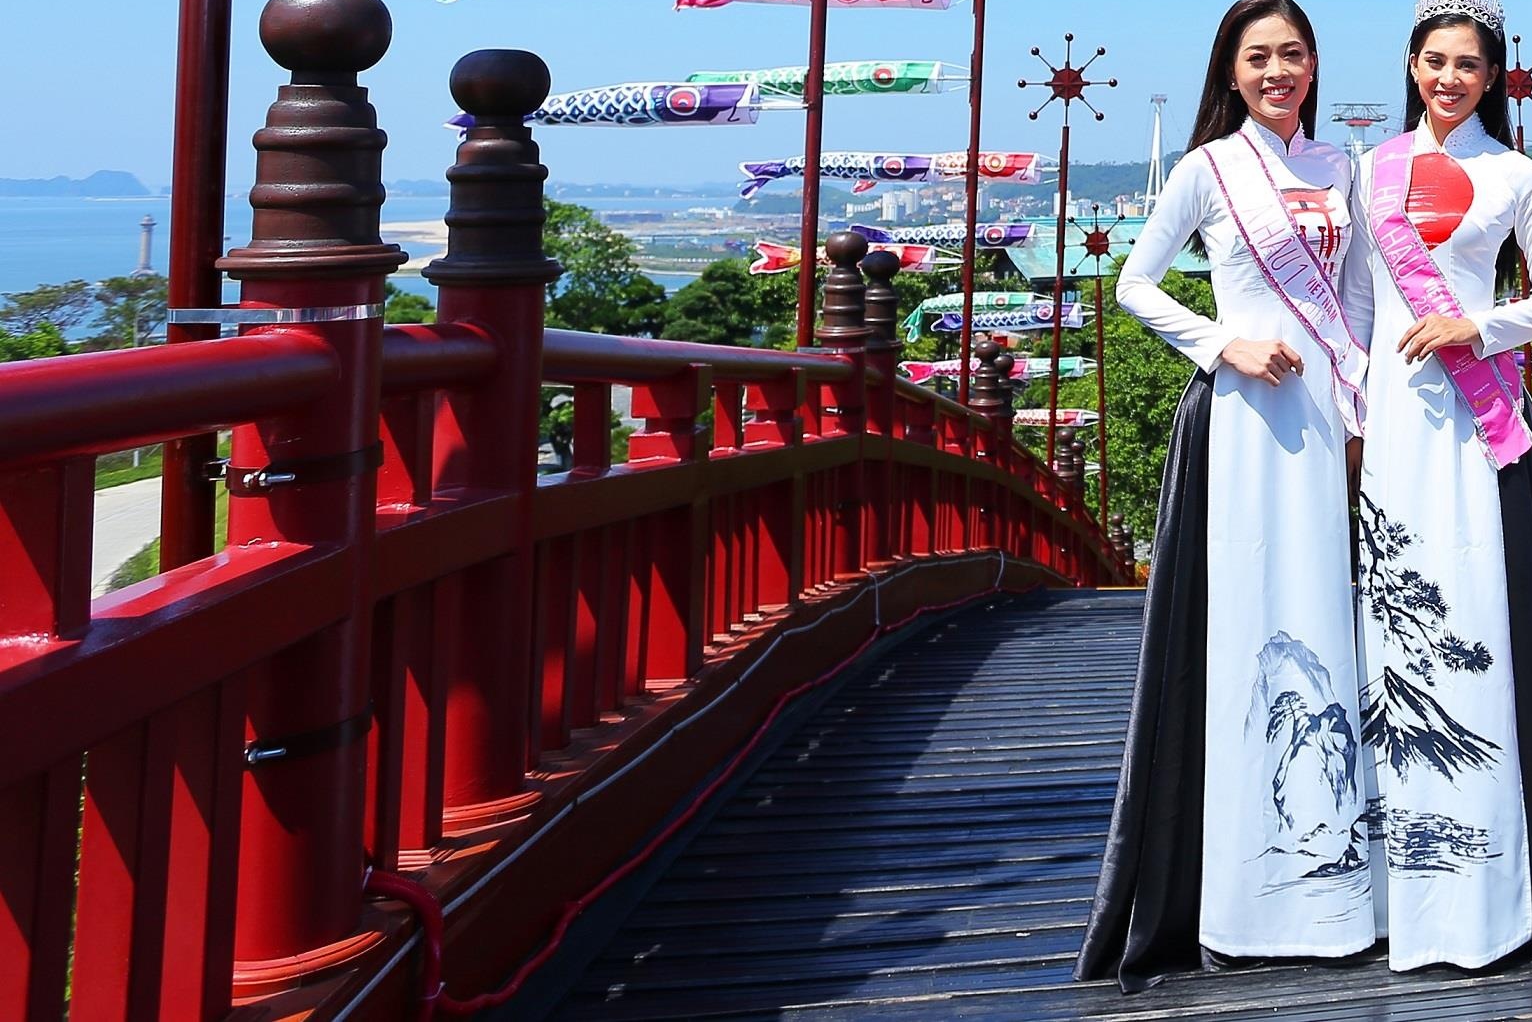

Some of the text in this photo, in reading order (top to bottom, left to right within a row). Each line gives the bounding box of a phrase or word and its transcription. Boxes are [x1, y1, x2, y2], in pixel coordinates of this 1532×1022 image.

[1373, 185, 1401, 230] HOA
[1283, 264, 1308, 286] 1
[1321, 296, 1338, 323] NAM
[1413, 297, 1432, 316] 20
